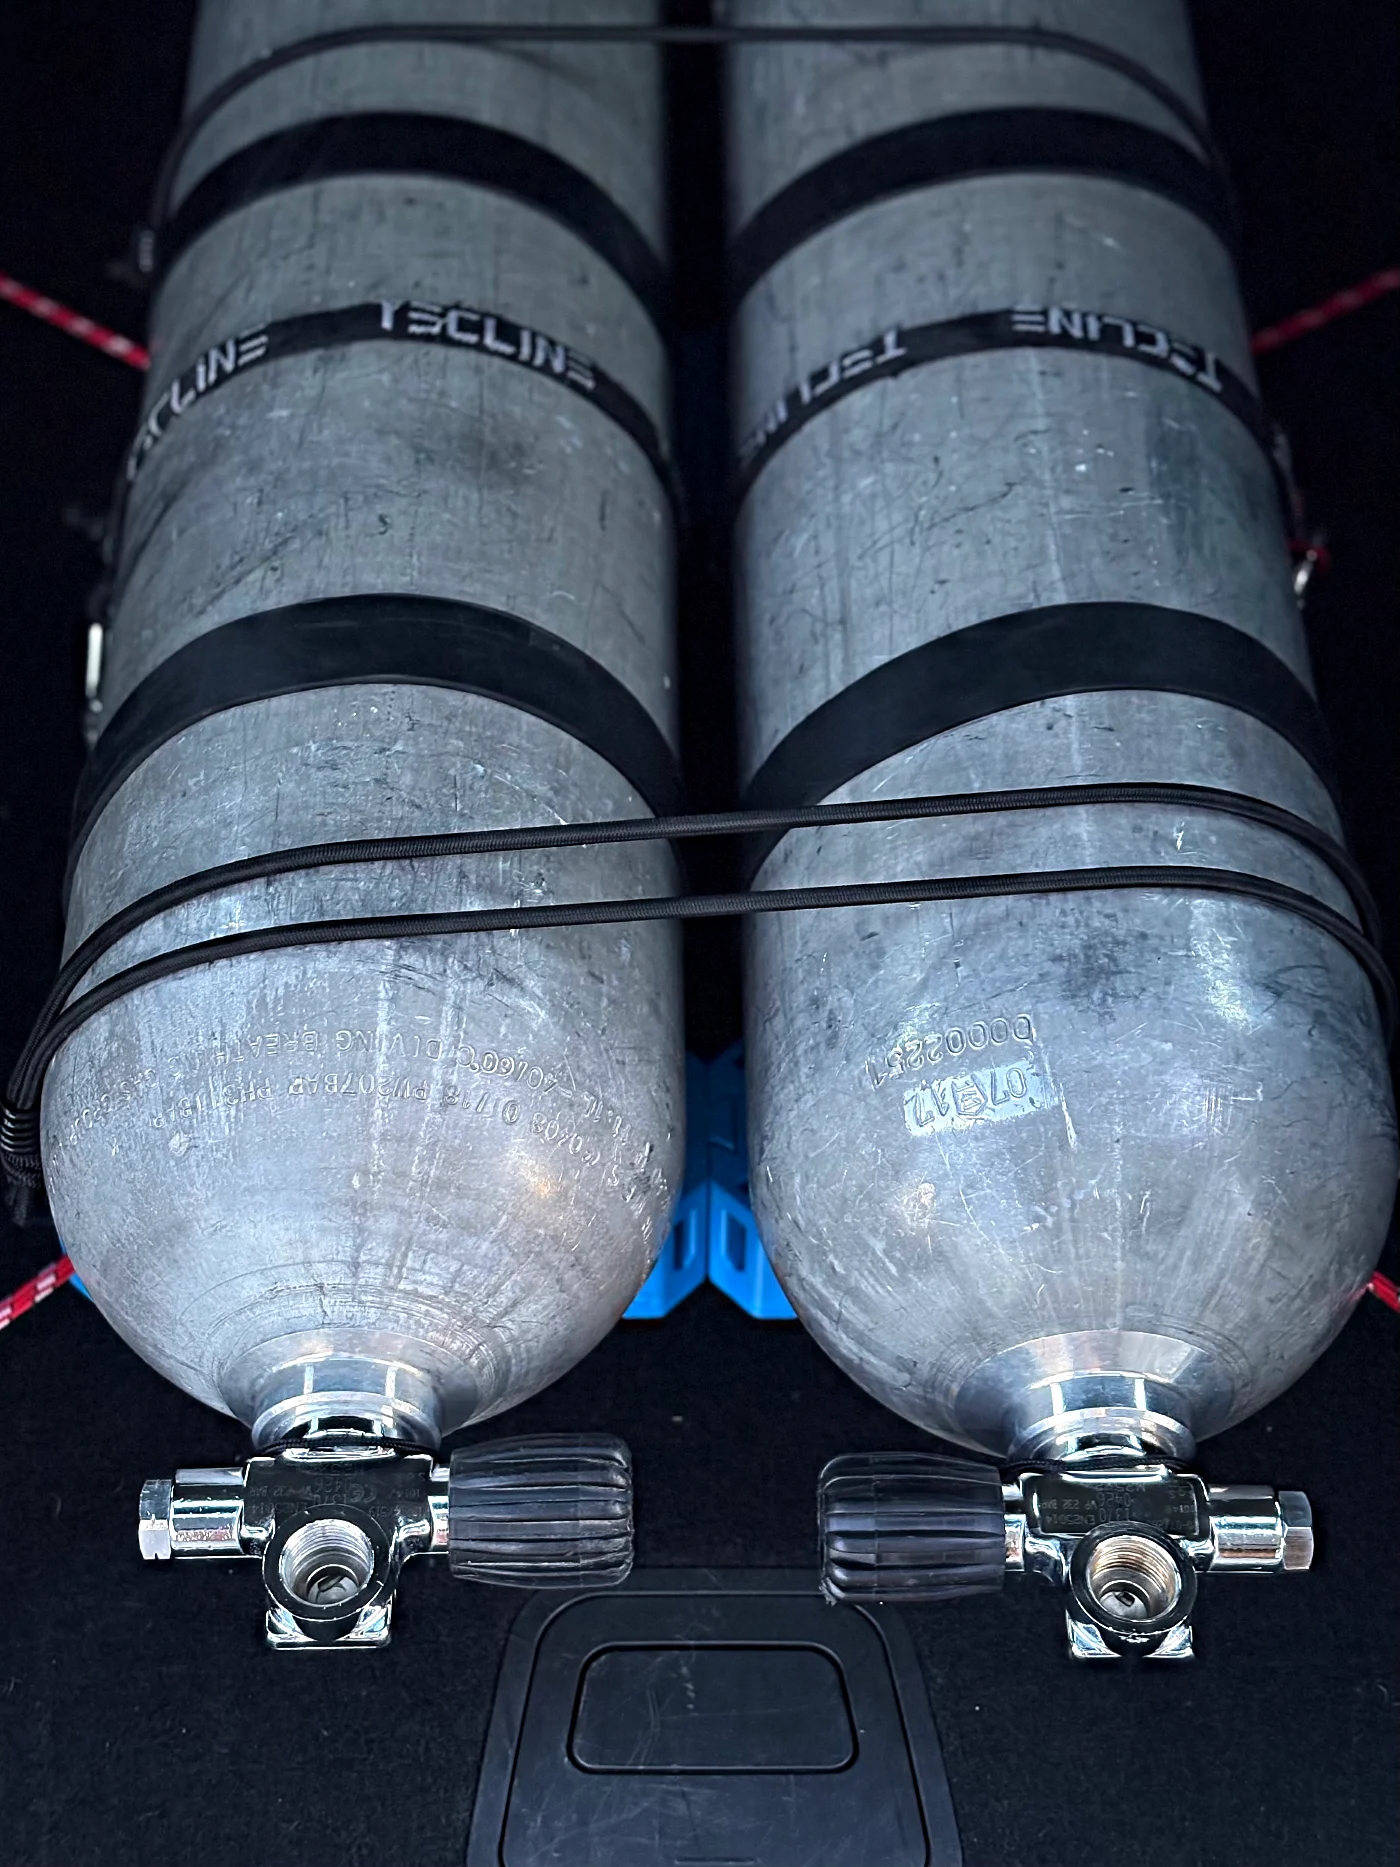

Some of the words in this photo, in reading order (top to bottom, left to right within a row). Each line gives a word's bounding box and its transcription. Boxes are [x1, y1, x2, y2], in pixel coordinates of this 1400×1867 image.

[378, 299, 596, 390] TECLINE
[1012, 306, 1222, 392] TECLINE
[337, 1029, 443, 1061] DIVING
[990, 1066, 1028, 1106] 07
